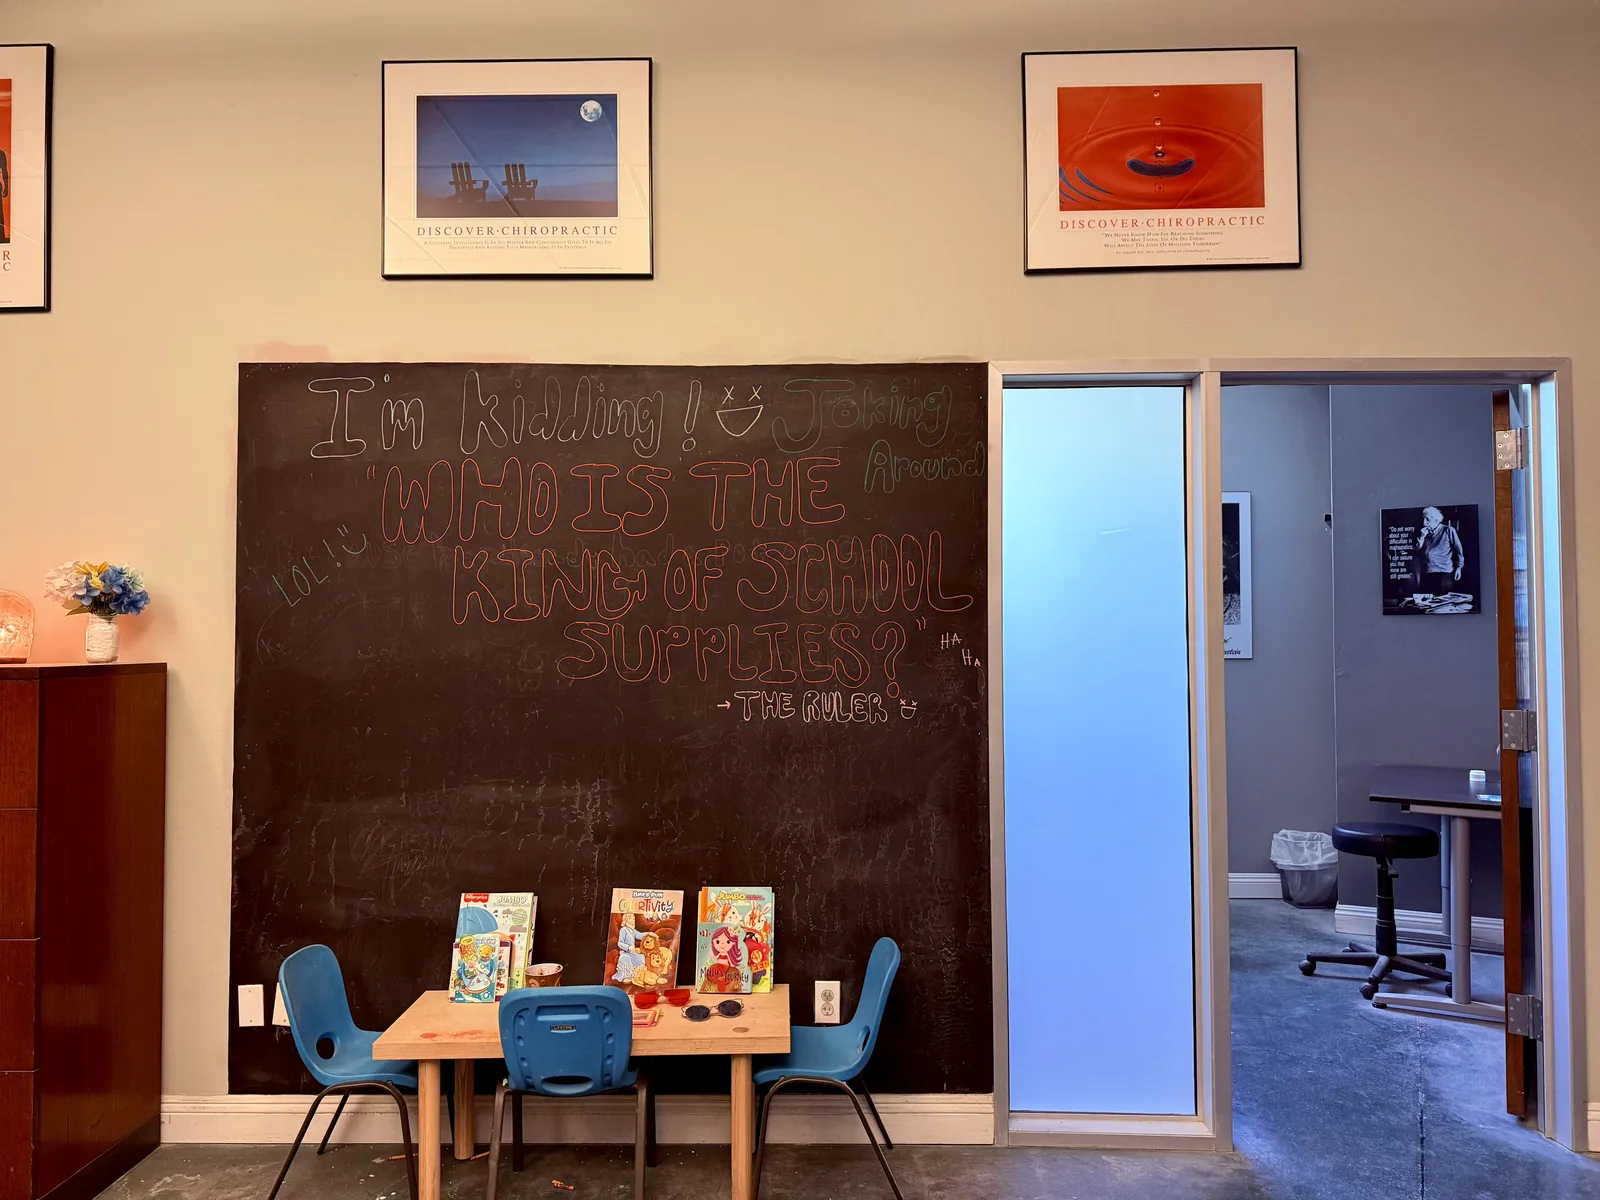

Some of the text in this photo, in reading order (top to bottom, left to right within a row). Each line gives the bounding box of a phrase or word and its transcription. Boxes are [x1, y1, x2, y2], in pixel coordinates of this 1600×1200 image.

[771, 378, 953, 454] Joking
[569, 463, 672, 537] IS
[689, 457, 846, 532] THE
[864, 439, 985, 494] Around
[453, 545, 648, 625] KING
[663, 545, 729, 612] OF
[737, 530, 974, 616] SCHOOL
[939, 632, 963, 650] HA
[733, 690, 890, 724] THE RULER
